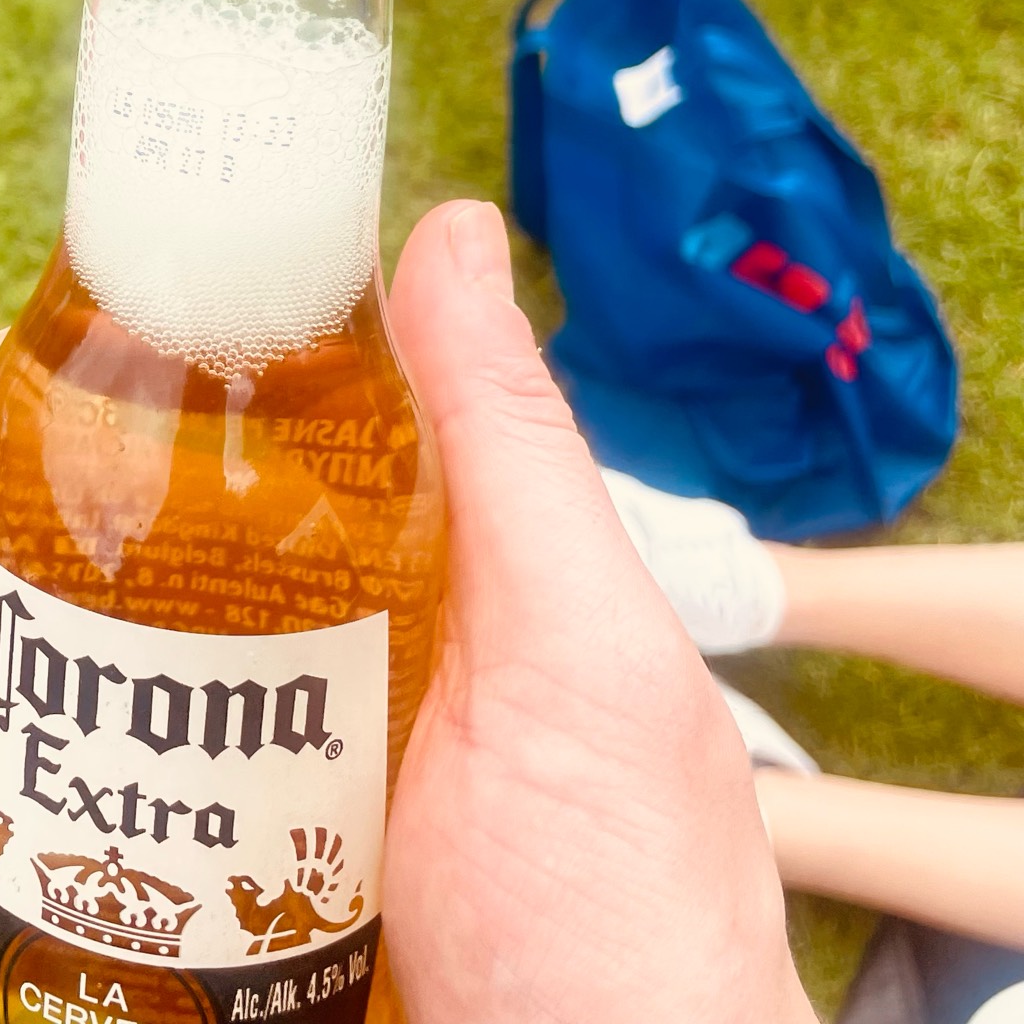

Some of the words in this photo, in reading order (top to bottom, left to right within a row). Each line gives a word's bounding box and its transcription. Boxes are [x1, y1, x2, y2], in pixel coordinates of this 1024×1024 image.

[19, 723, 240, 849] Extra
[19, 982, 138, 1024] CERV
[79, 972, 129, 1012] LA
